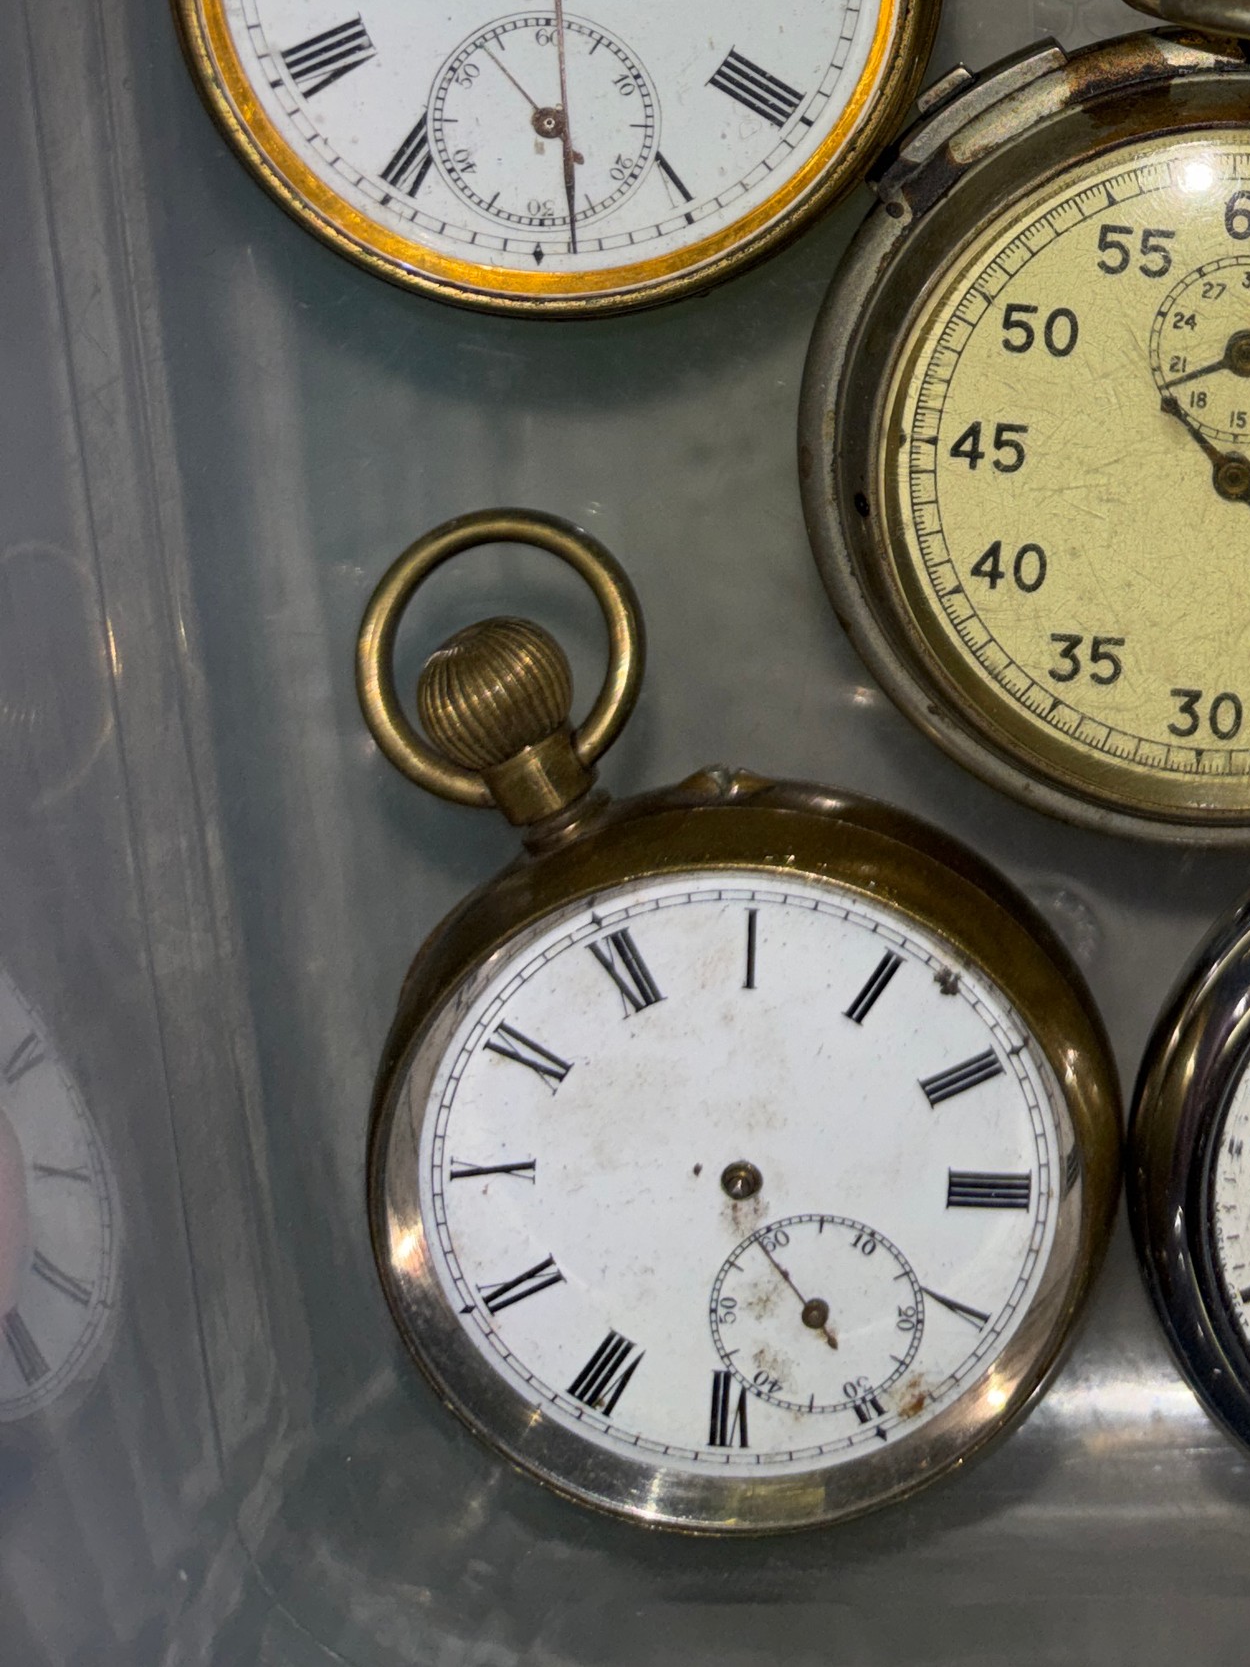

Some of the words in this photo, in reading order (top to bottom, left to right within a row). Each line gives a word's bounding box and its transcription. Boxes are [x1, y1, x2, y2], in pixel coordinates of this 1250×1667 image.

[455, 61, 481, 91] 50
[612, 73, 637, 98] 10
[609, 153, 633, 182] 20
[527, 199, 555, 218] 30
[1096, 224, 1175, 279] 55
[1201, 281, 1227, 300] 27
[1000, 302, 1080, 357] 50
[1172, 312, 1197, 330] 24
[1169, 355, 1187, 373] 21
[1190, 391, 1207, 409] 18
[1229, 411, 1248, 429] 15
[949, 421, 1029, 474] 45
[970, 540, 1048, 594] 40
[1048, 633, 1126, 686] 35
[1166, 688, 1243, 741] 30
[850, 1235, 878, 1256] 10
[718, 1297, 738, 1325] 50
[896, 1304, 918, 1332] 20
[752, 1369, 785, 1393] 40
